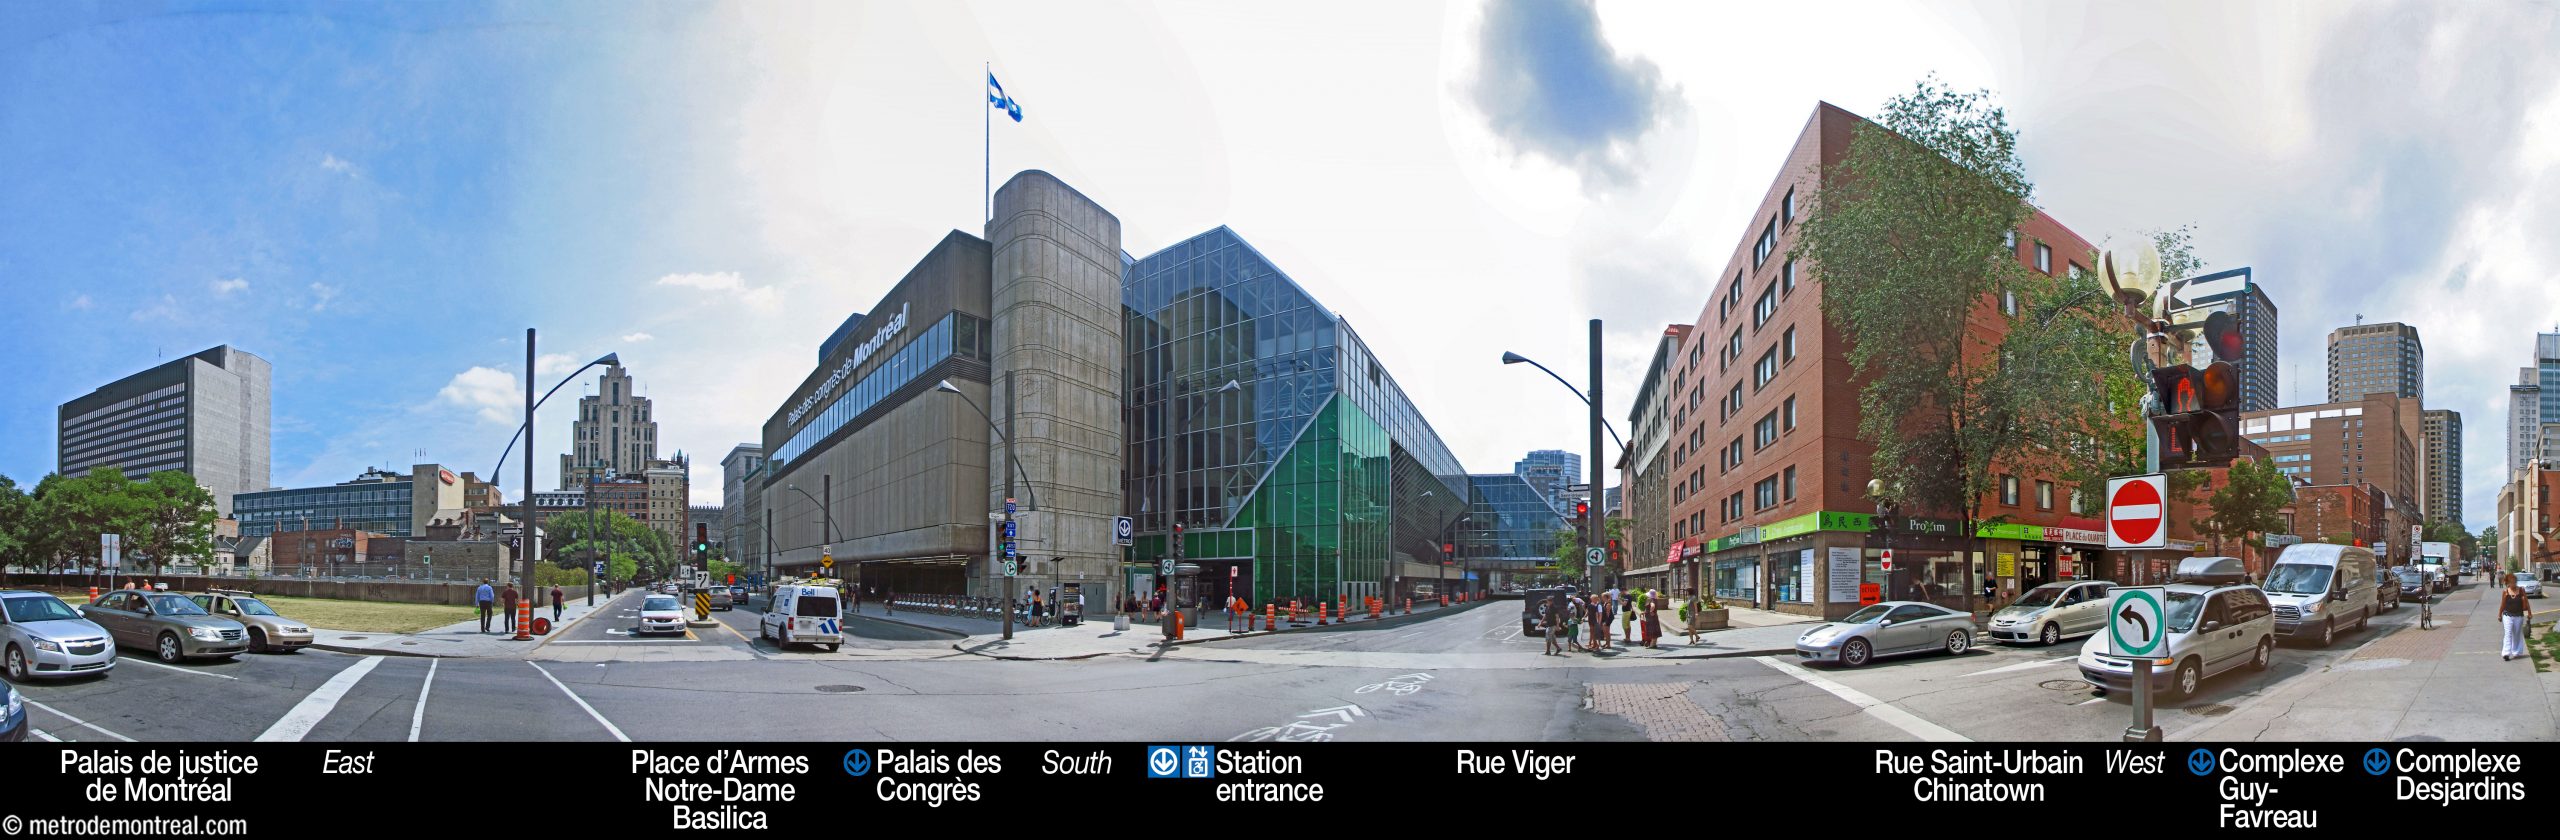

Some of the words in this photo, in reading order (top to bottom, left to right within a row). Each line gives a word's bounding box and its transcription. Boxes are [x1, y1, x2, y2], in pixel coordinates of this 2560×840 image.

[788, 407, 802, 428] Palais
[801, 396, 812, 415] des
[814, 370, 841, 404] congrès
[842, 358, 853, 380] de
[853, 301, 911, 370] Montréal
[2065, 530, 2082, 541] PLACE
[2087, 533, 2106, 543] QUARTIE
[801, 587, 815, 596] Bell
